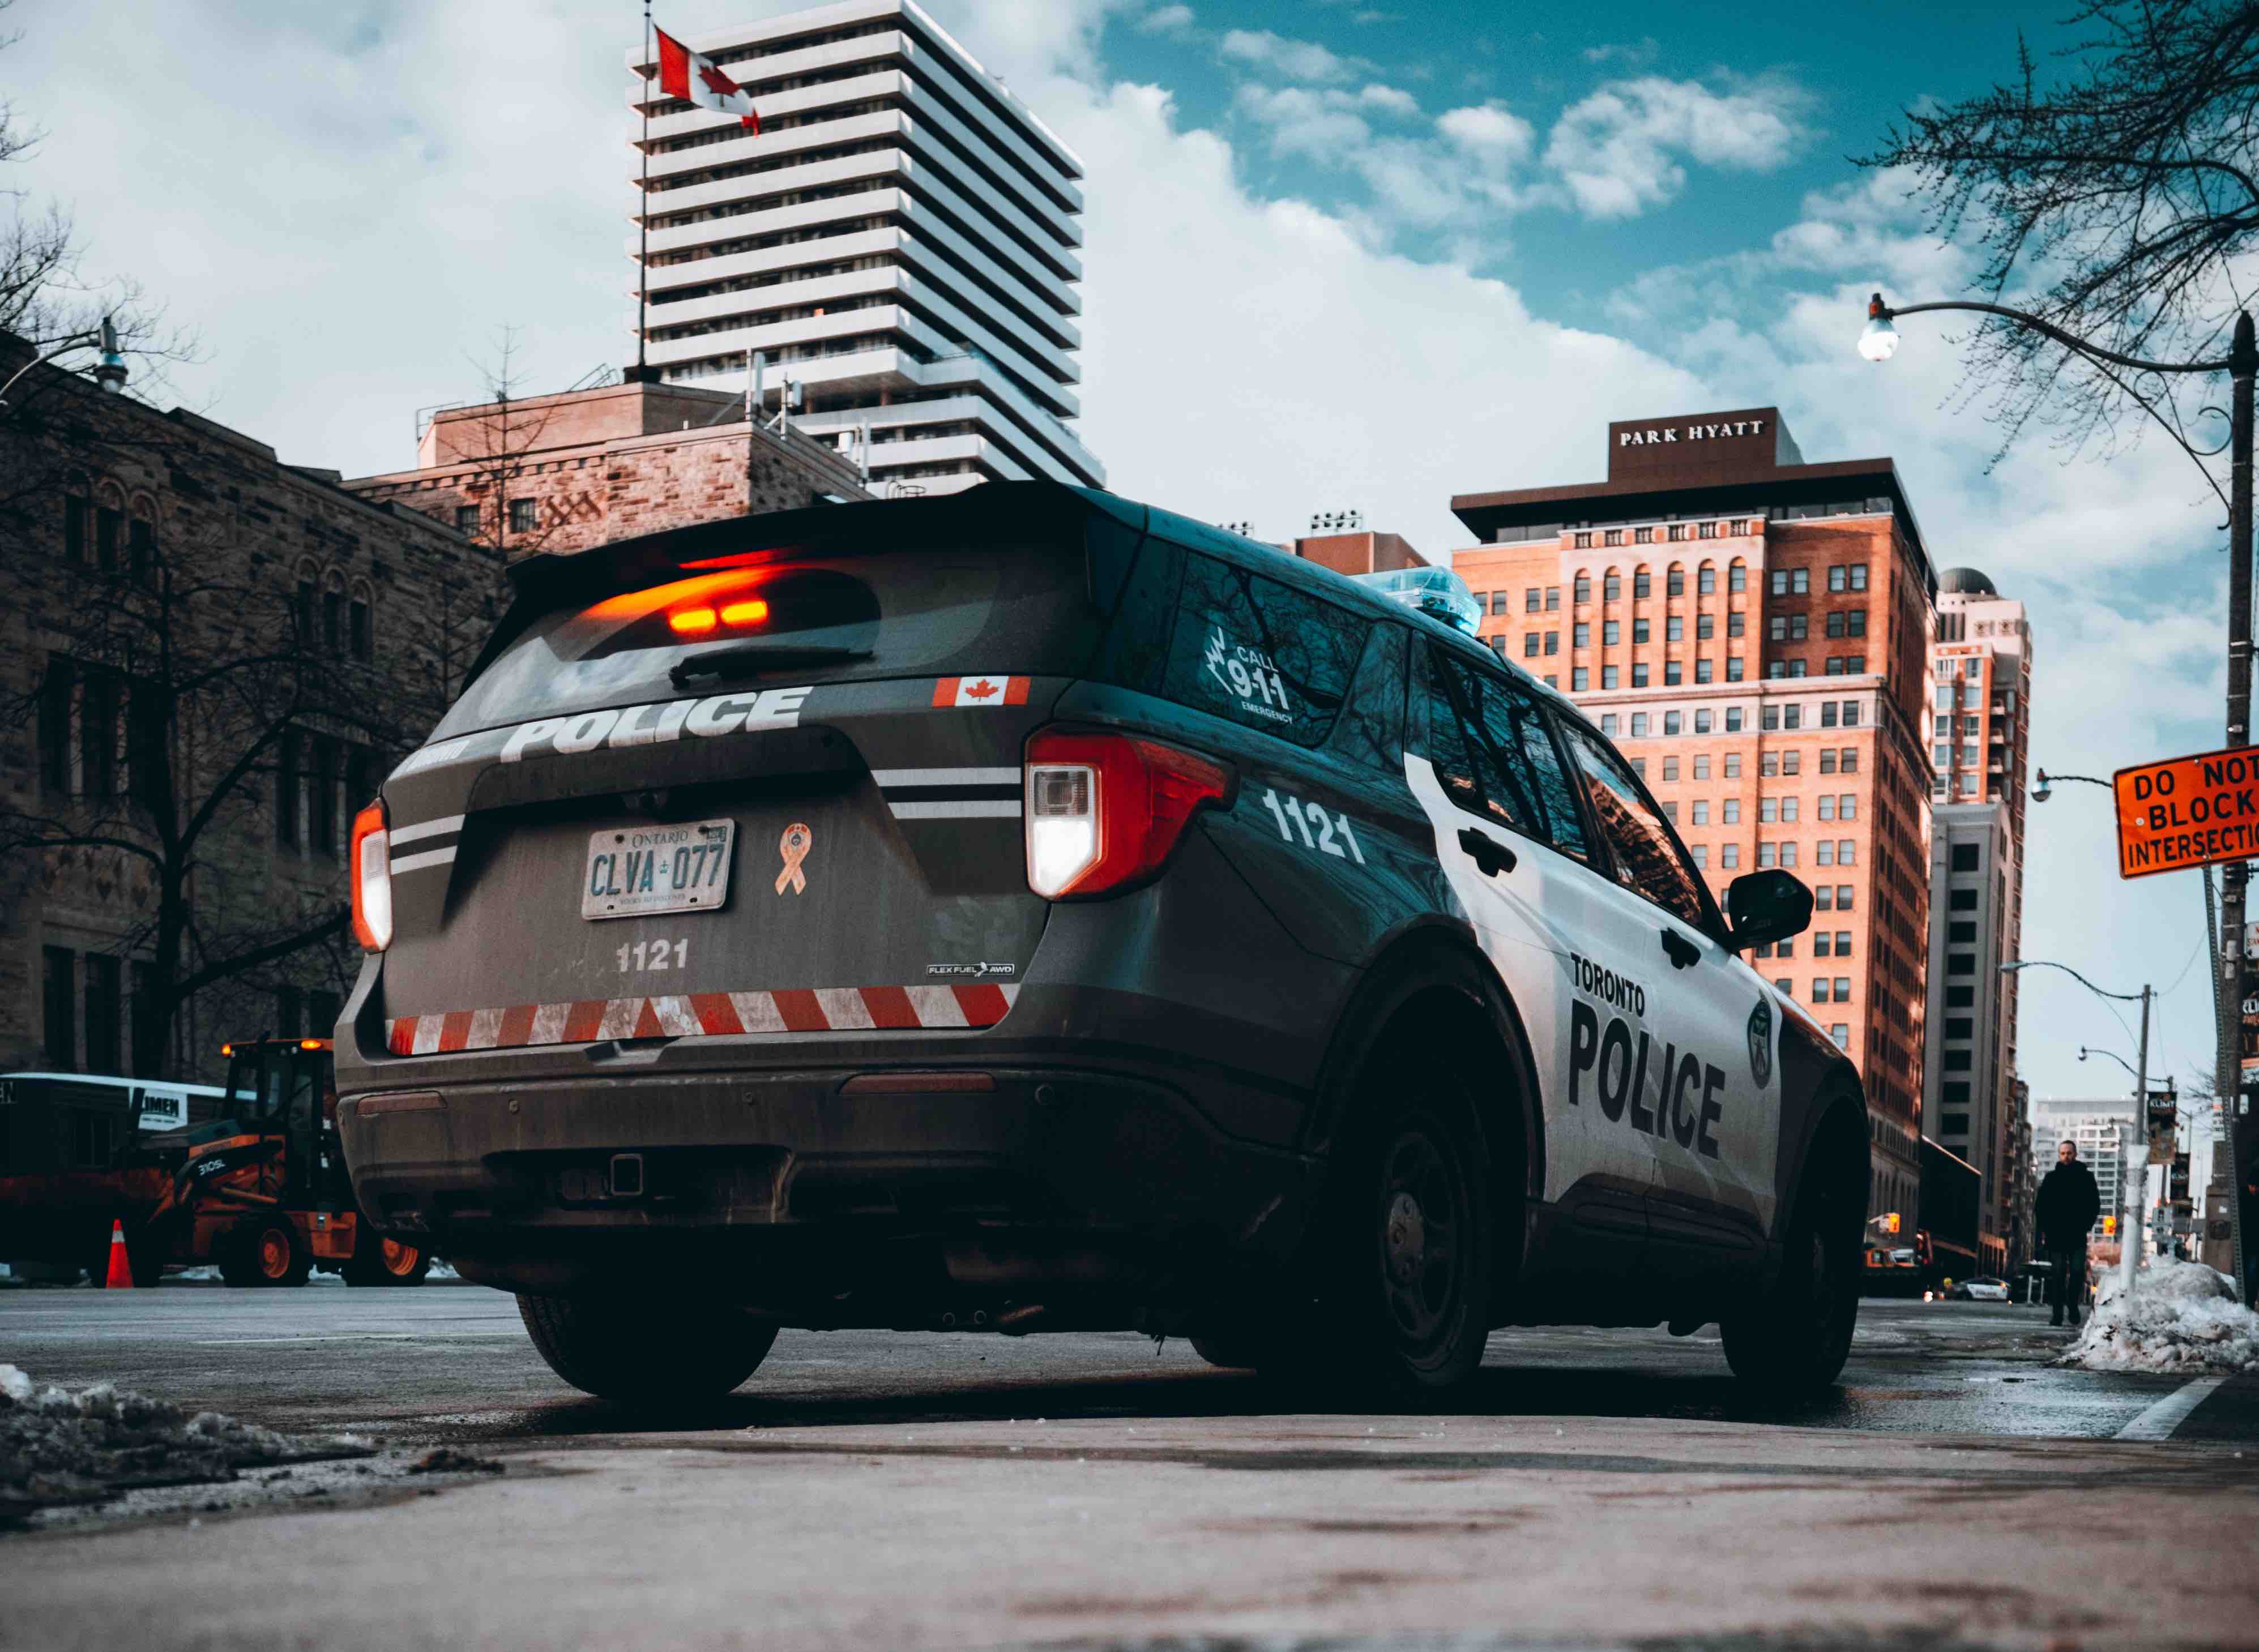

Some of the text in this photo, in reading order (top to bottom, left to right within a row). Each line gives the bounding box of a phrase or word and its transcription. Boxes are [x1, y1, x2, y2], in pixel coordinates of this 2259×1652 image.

[1620, 421, 1763, 446] PARK HYATT
[1236, 646, 1279, 673] CALL
[501, 686, 813, 763] POLICE
[1241, 701, 1293, 725] EMERGENCY
[2134, 755, 2259, 801] DO NOT
[1262, 789, 1365, 864] 1121
[2149, 789, 2256, 831] BLOCK
[632, 831, 689, 849] ONTARIO
[590, 843, 725, 896] CLVA 077
[616, 938, 689, 972] 1121
[1571, 952, 1645, 1017] TORONTO
[1569, 998, 1726, 1159] POLICE
[141, 1097, 179, 1118] IMEN
